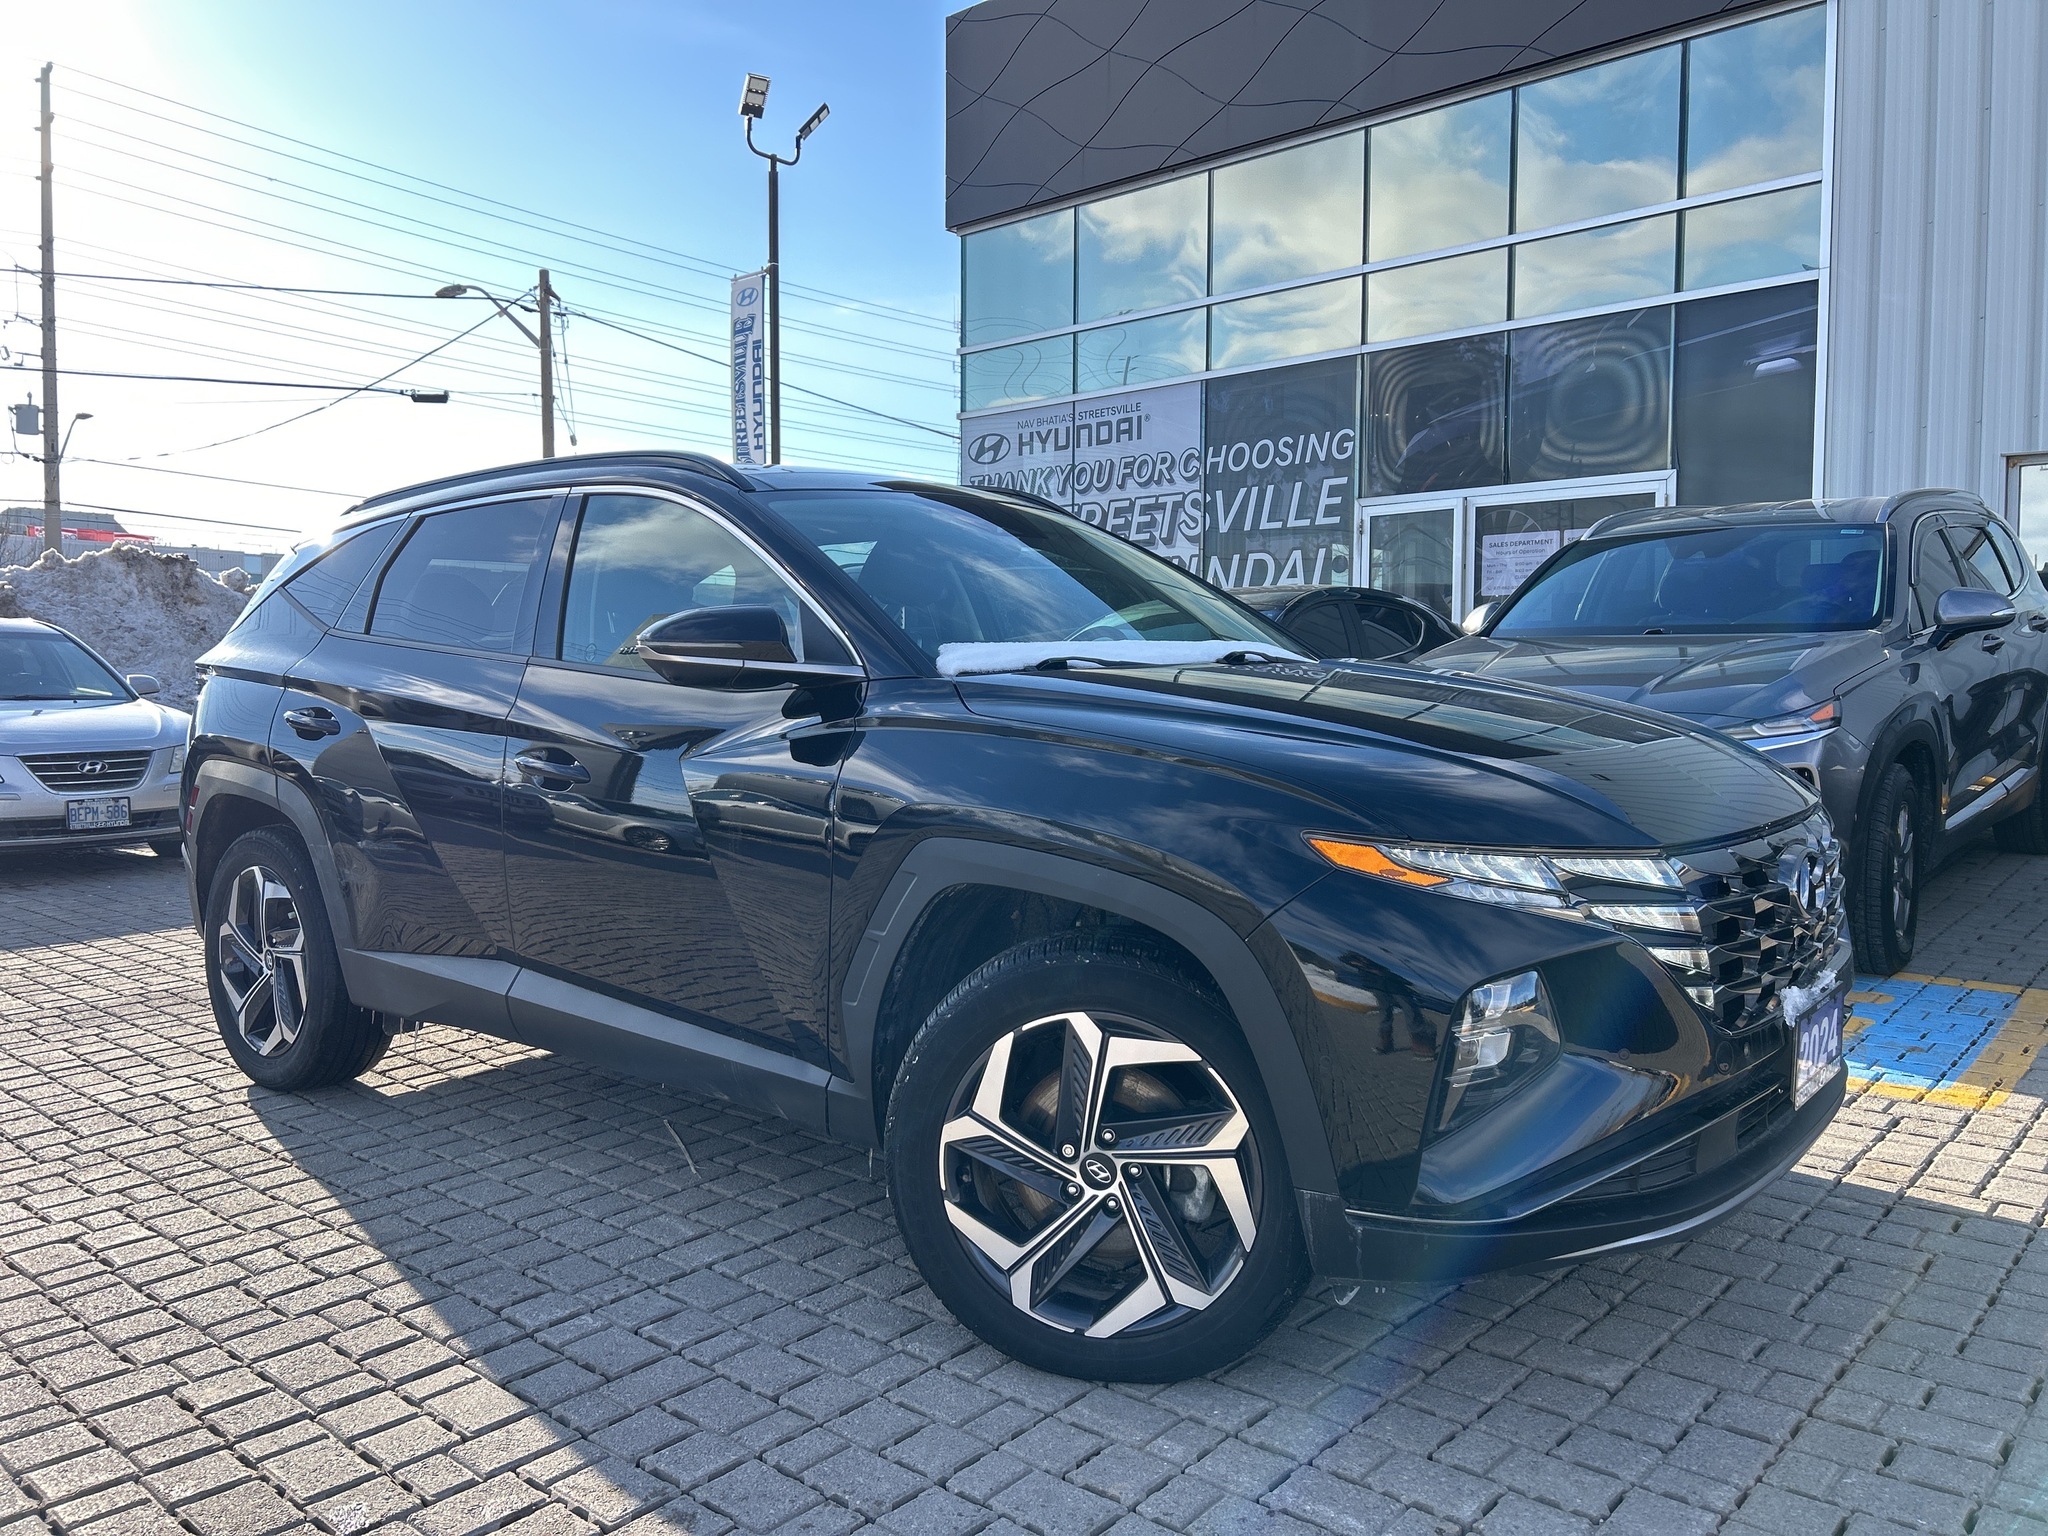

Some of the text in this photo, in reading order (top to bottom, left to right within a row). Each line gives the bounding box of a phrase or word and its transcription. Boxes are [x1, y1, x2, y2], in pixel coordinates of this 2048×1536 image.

[752, 339, 763, 450] HYUNDAI
[1017, 402, 1142, 430] NAV BHATIA'S STREETSVILLE
[1018, 415, 1142, 456] HYUNDAI
[1056, 458, 1113, 496] YOU
[1117, 450, 1178, 490] FOR
[1178, 428, 1355, 481] CHOOSING
[1062, 476, 1348, 544] REETSVILLE
[1488, 538, 1553, 549] SALES DEPARTMENT
[1519, 548, 1545, 557] Operation
[70, 804, 127, 822] BEPM 586
[1801, 1008, 1838, 1080] 2024
